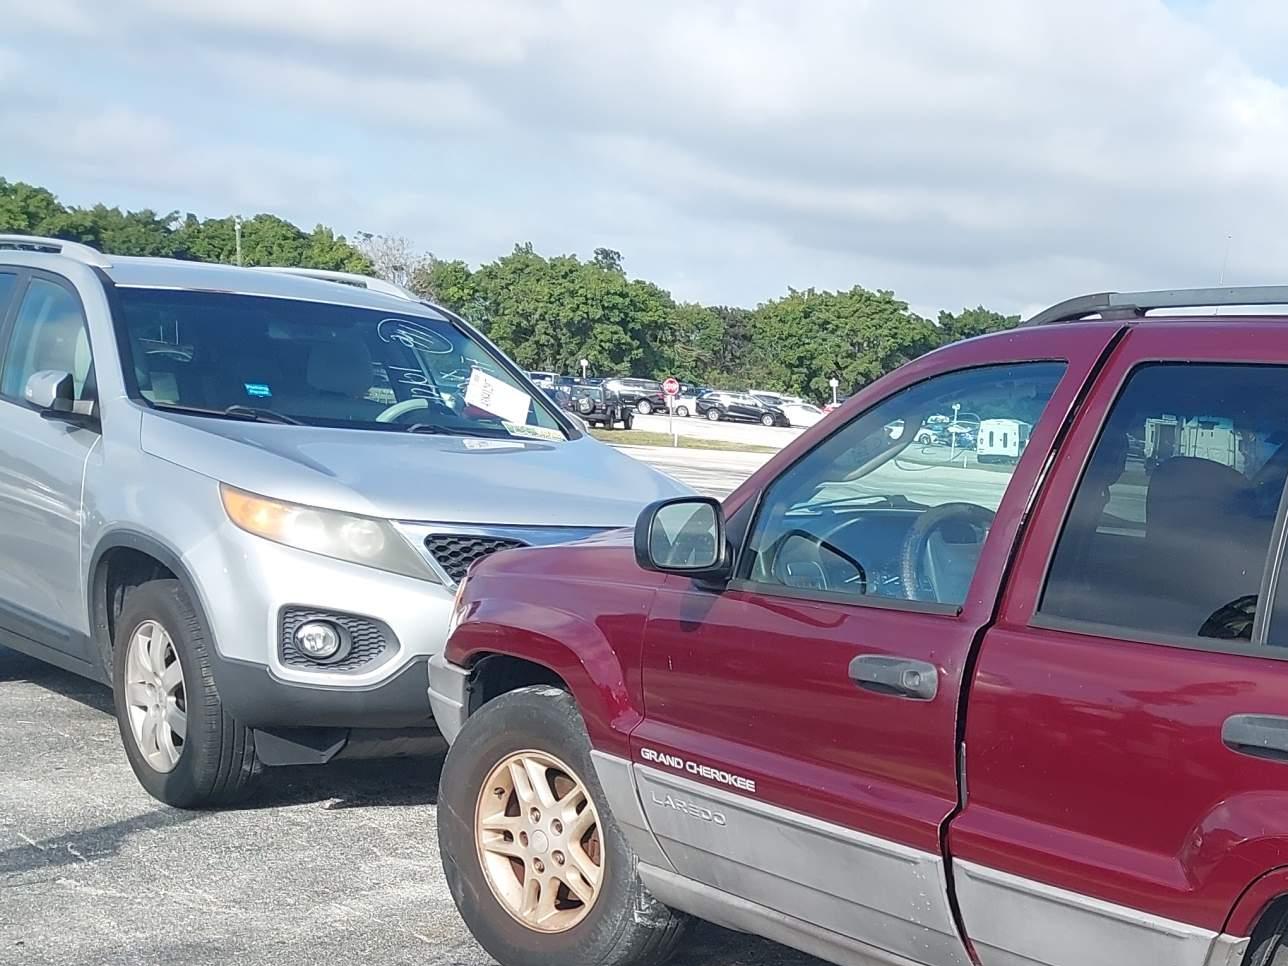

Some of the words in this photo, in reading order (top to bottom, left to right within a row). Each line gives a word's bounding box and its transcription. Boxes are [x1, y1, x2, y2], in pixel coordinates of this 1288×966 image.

[641, 748, 684, 769] GRAND
[686, 761, 756, 792] CHEROKEE
[651, 791, 727, 826] LAREDO
